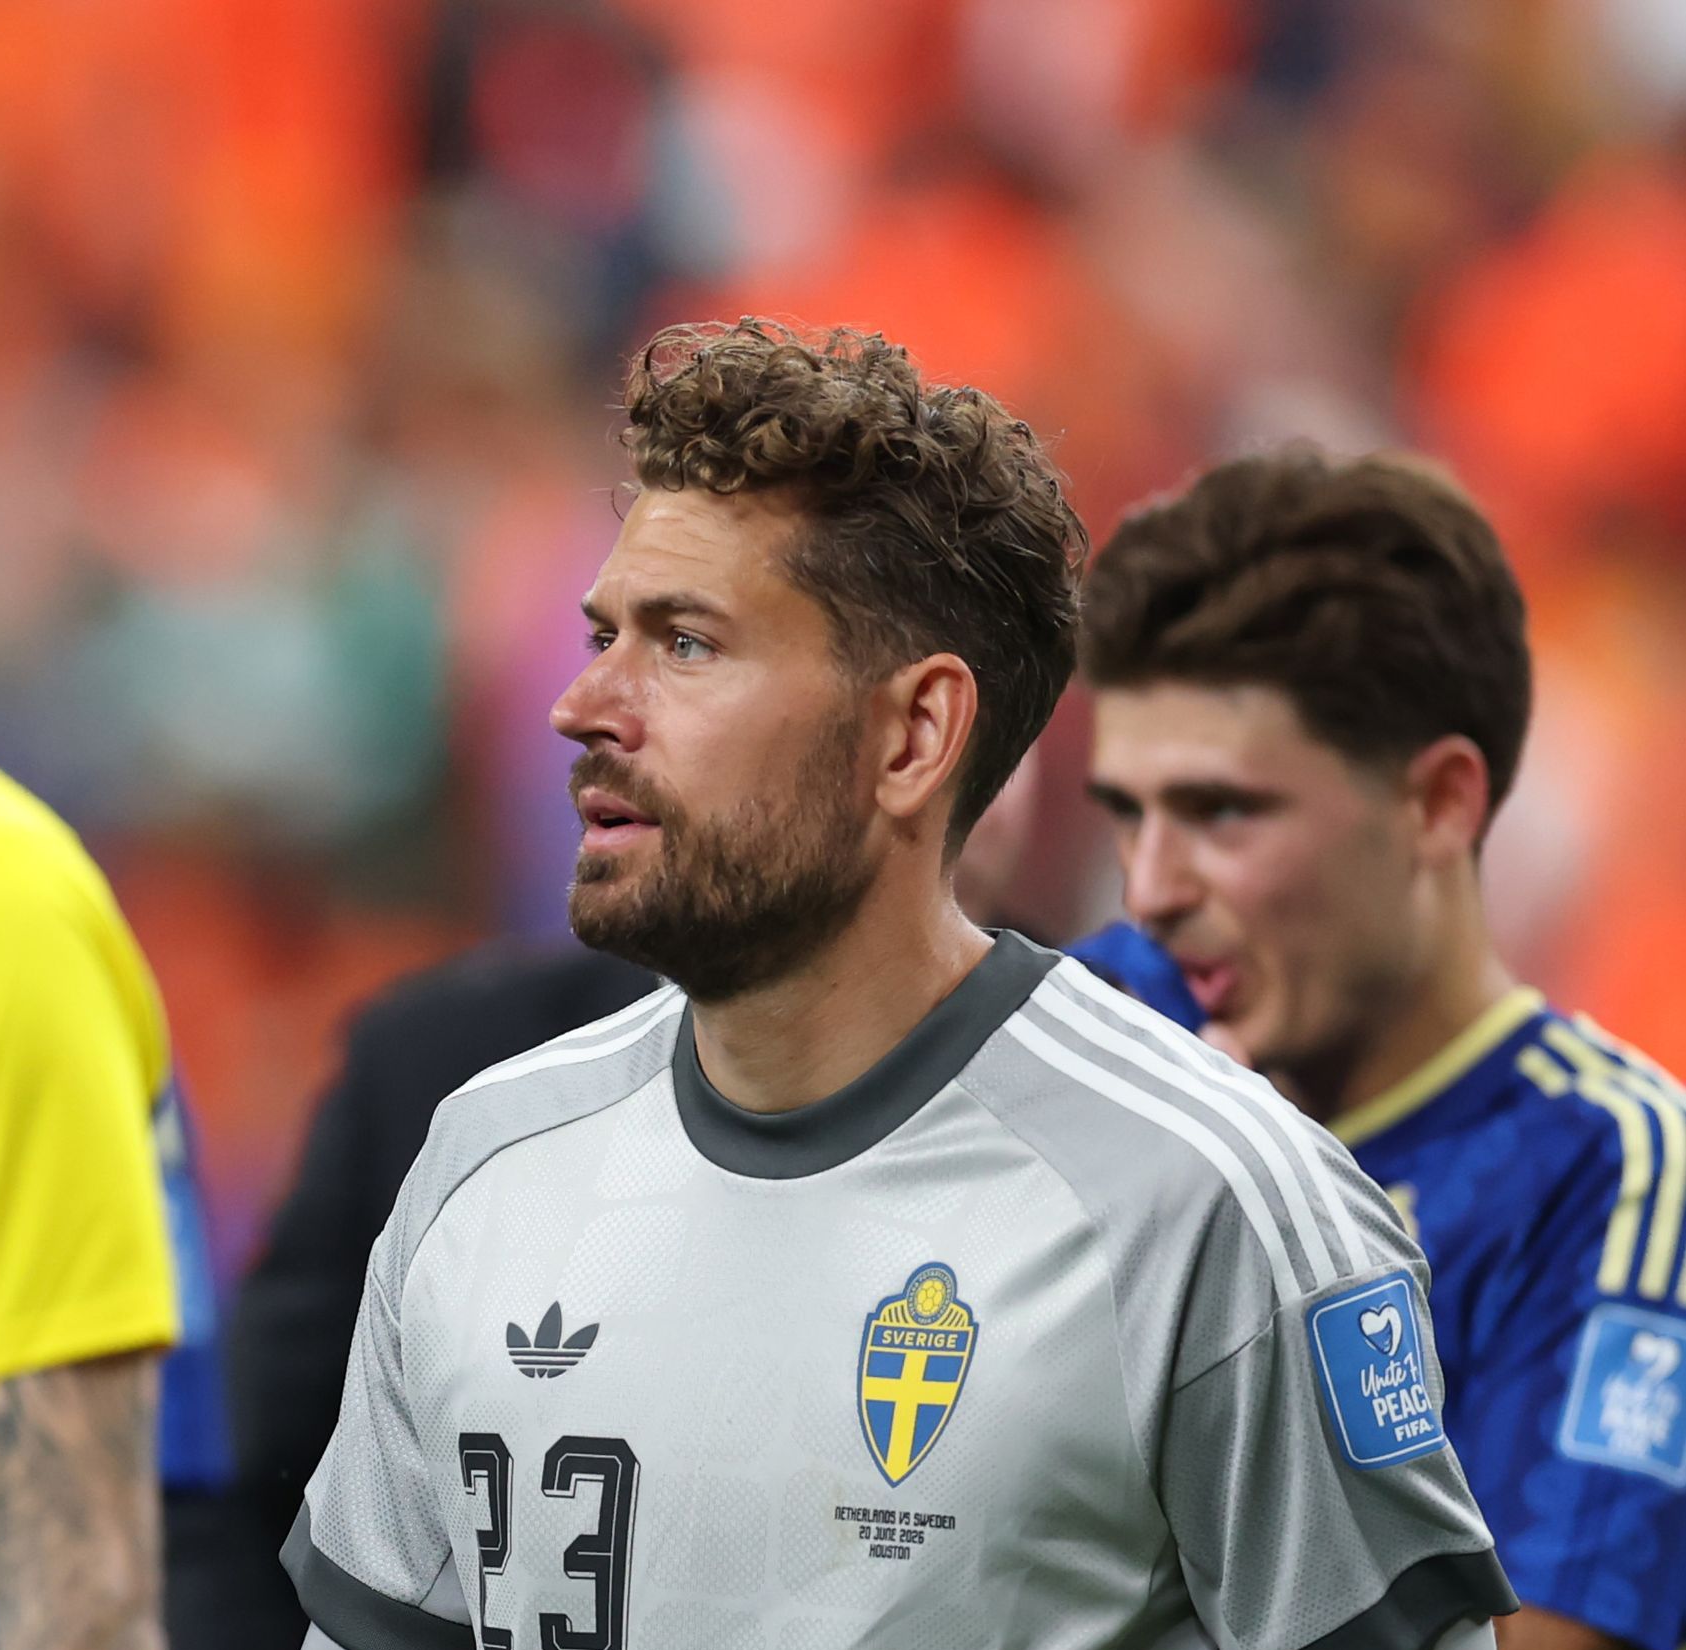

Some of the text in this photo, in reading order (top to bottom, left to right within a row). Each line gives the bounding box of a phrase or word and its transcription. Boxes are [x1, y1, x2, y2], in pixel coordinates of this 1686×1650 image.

[882, 1330, 958, 1348] SVERIGE
[1360, 1360, 1407, 1397] Unite
[1394, 1418, 1433, 1442] FIFA
[834, 1506, 956, 1531] NETHERLANDS VS SWEDEN
[859, 1525, 925, 1545] 20 JUNE 2026
[869, 1543, 911, 1560] HOUSTON
